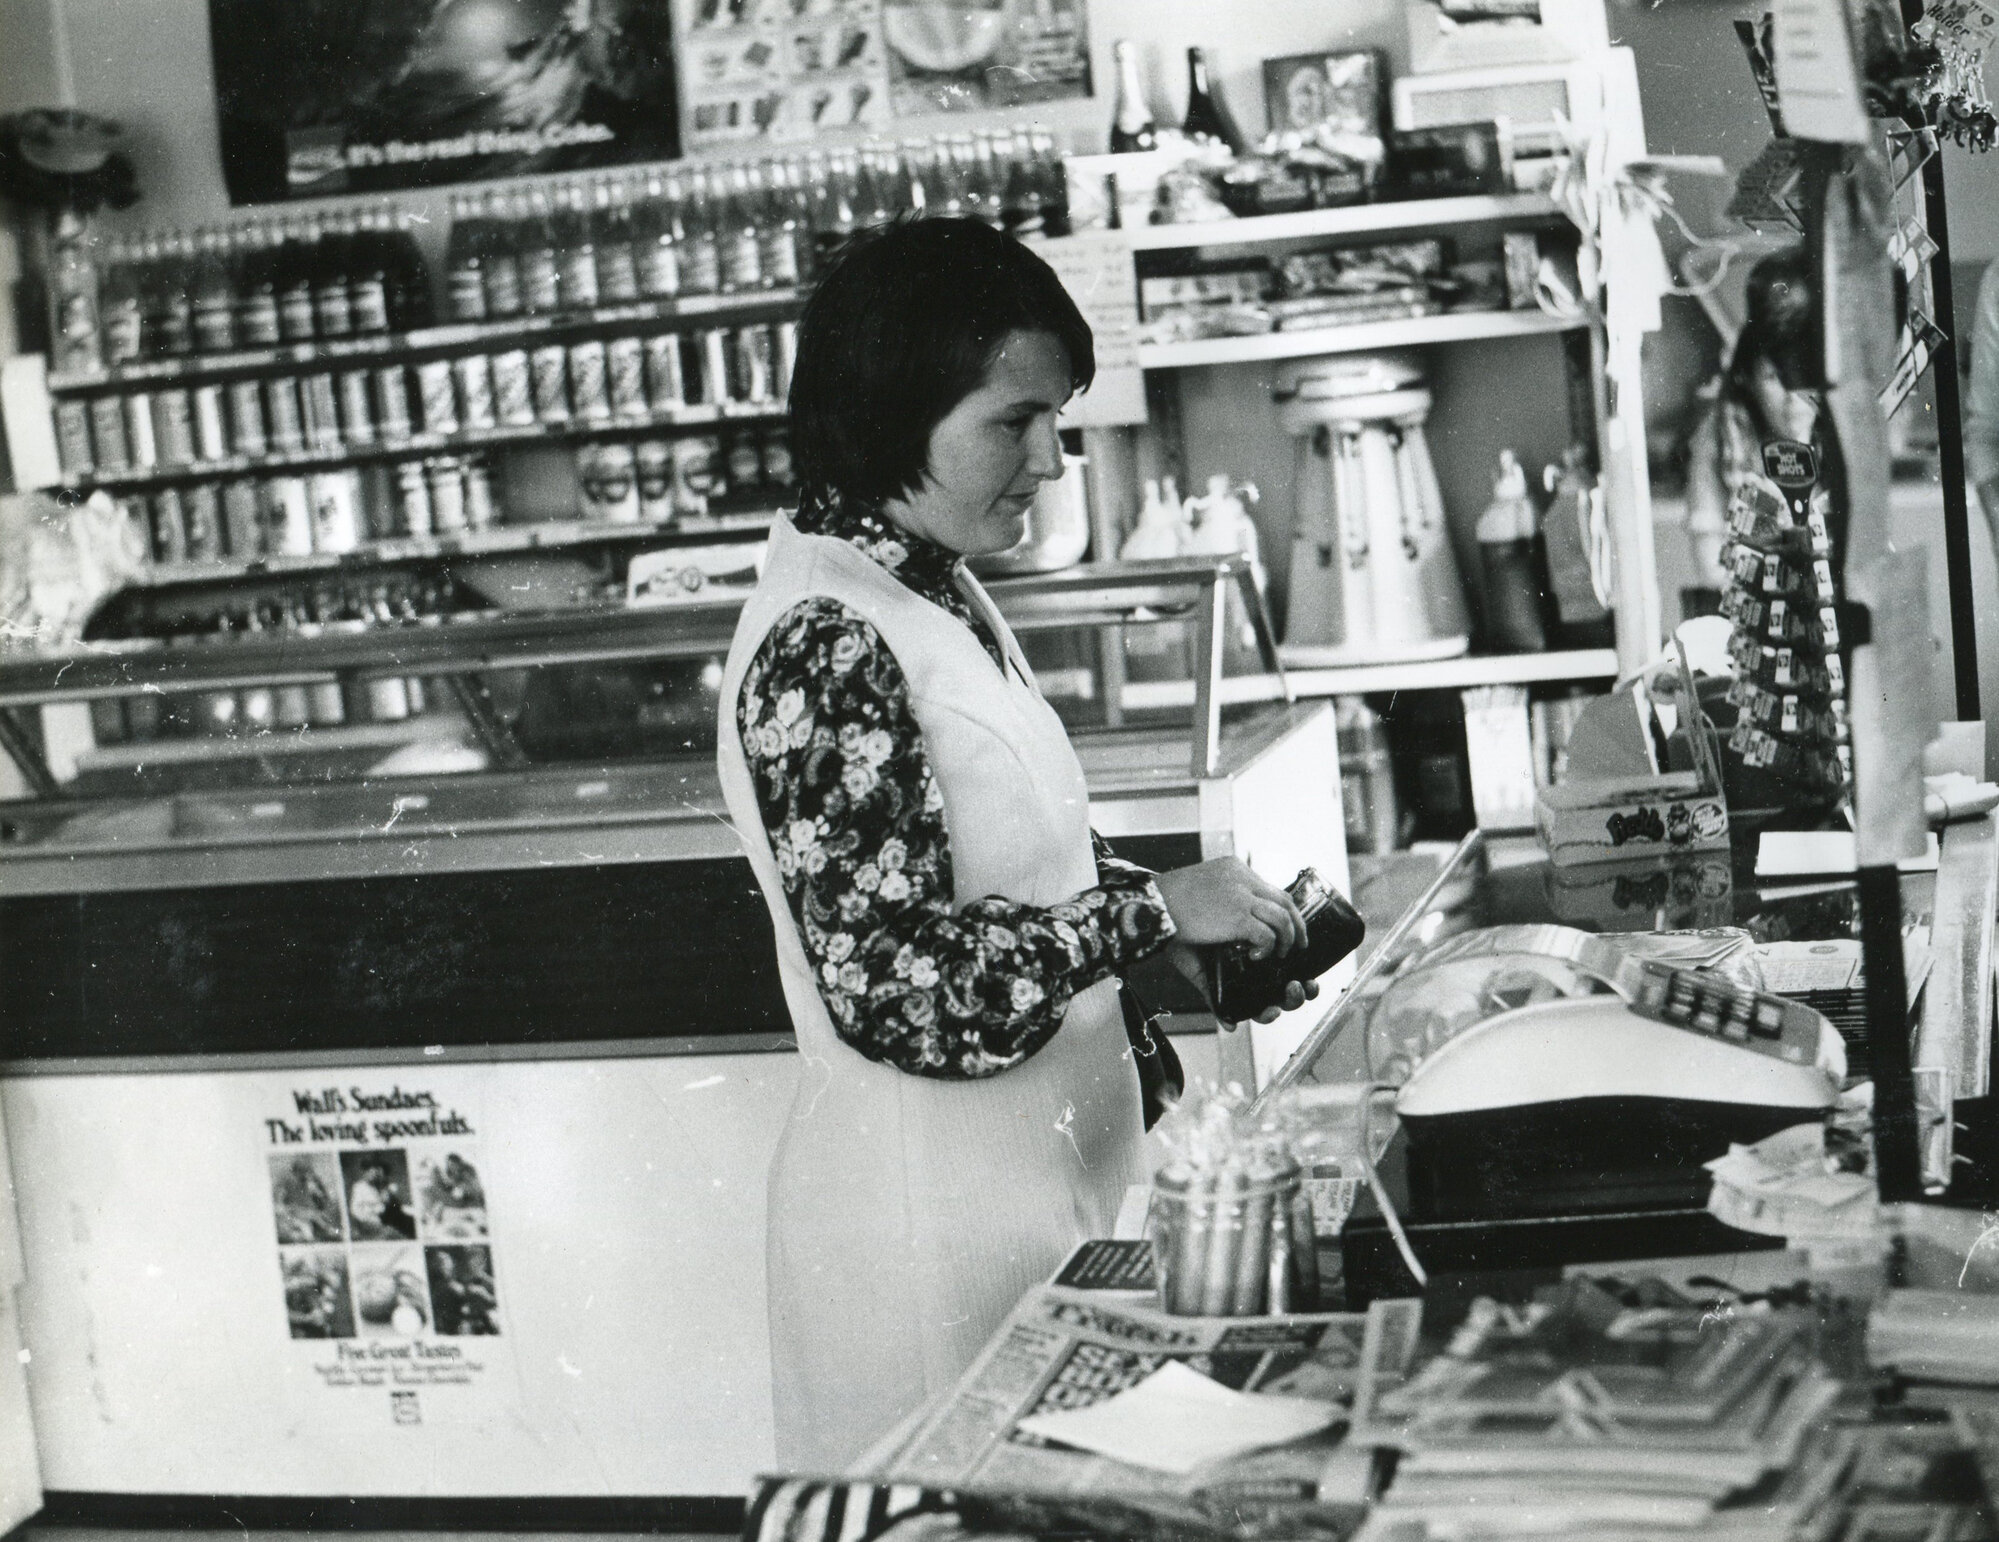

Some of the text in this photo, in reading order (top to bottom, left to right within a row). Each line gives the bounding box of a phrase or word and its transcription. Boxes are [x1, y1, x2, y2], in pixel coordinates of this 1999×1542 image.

[1926, 3, 1971, 36] Holder
[264, 1118, 304, 1145] The
[308, 1113, 369, 1145] loving
